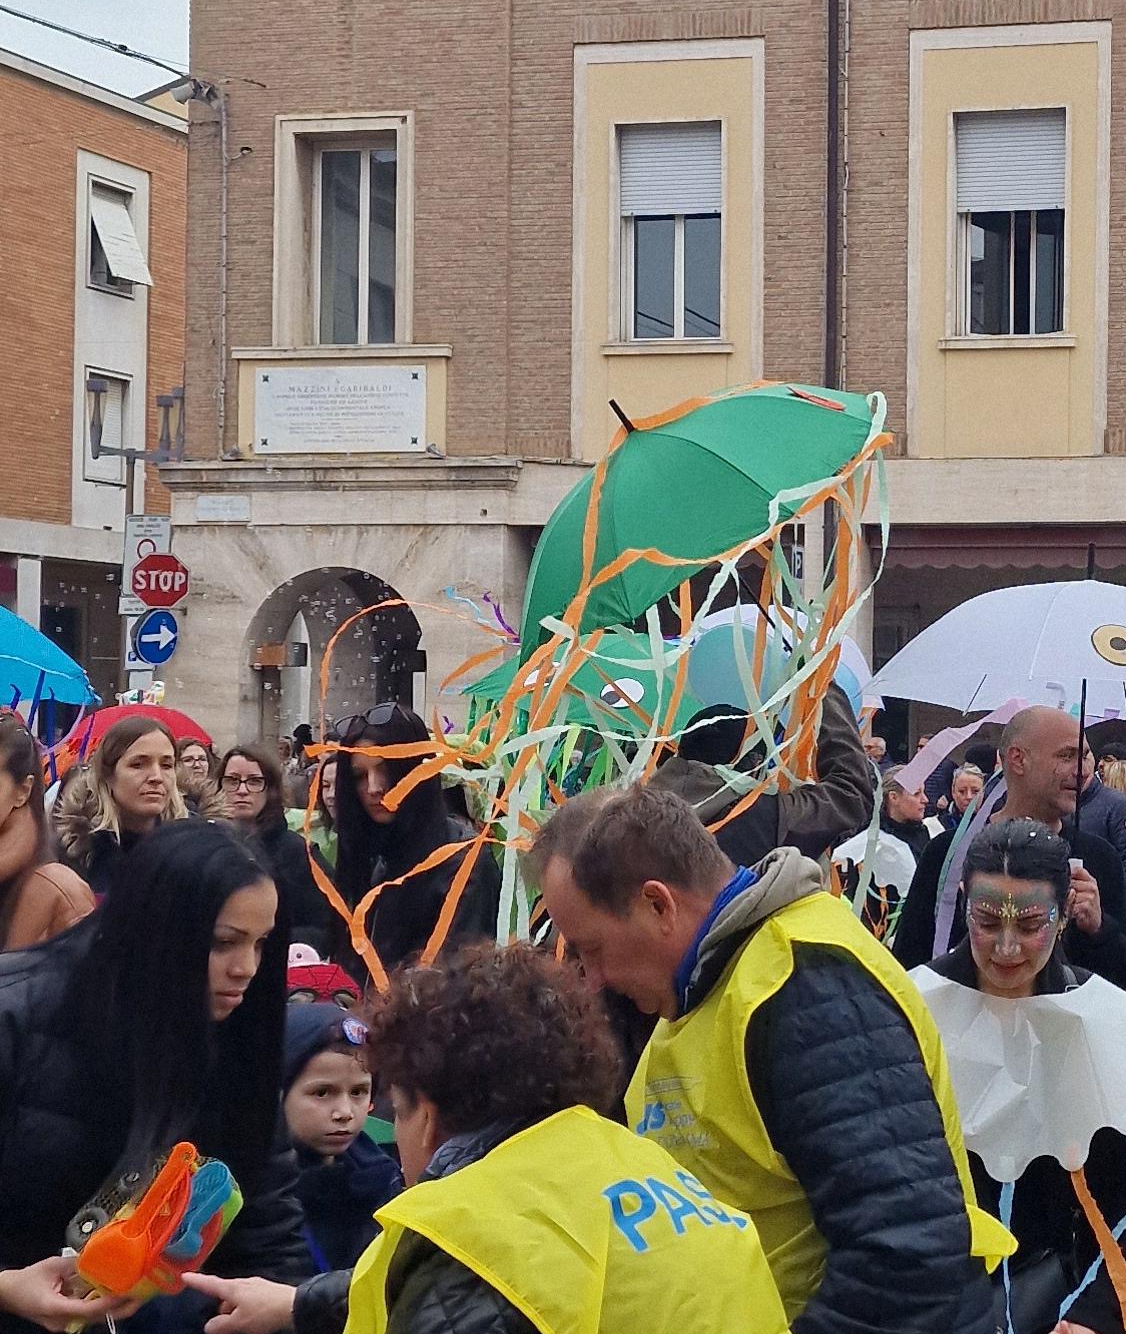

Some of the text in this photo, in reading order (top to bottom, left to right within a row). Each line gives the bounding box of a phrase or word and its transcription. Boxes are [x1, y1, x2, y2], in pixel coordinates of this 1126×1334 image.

[288, 385, 332, 393] MAZZINI
[342, 384, 392, 393] GARIBALDI
[134, 570, 187, 592] STOP
